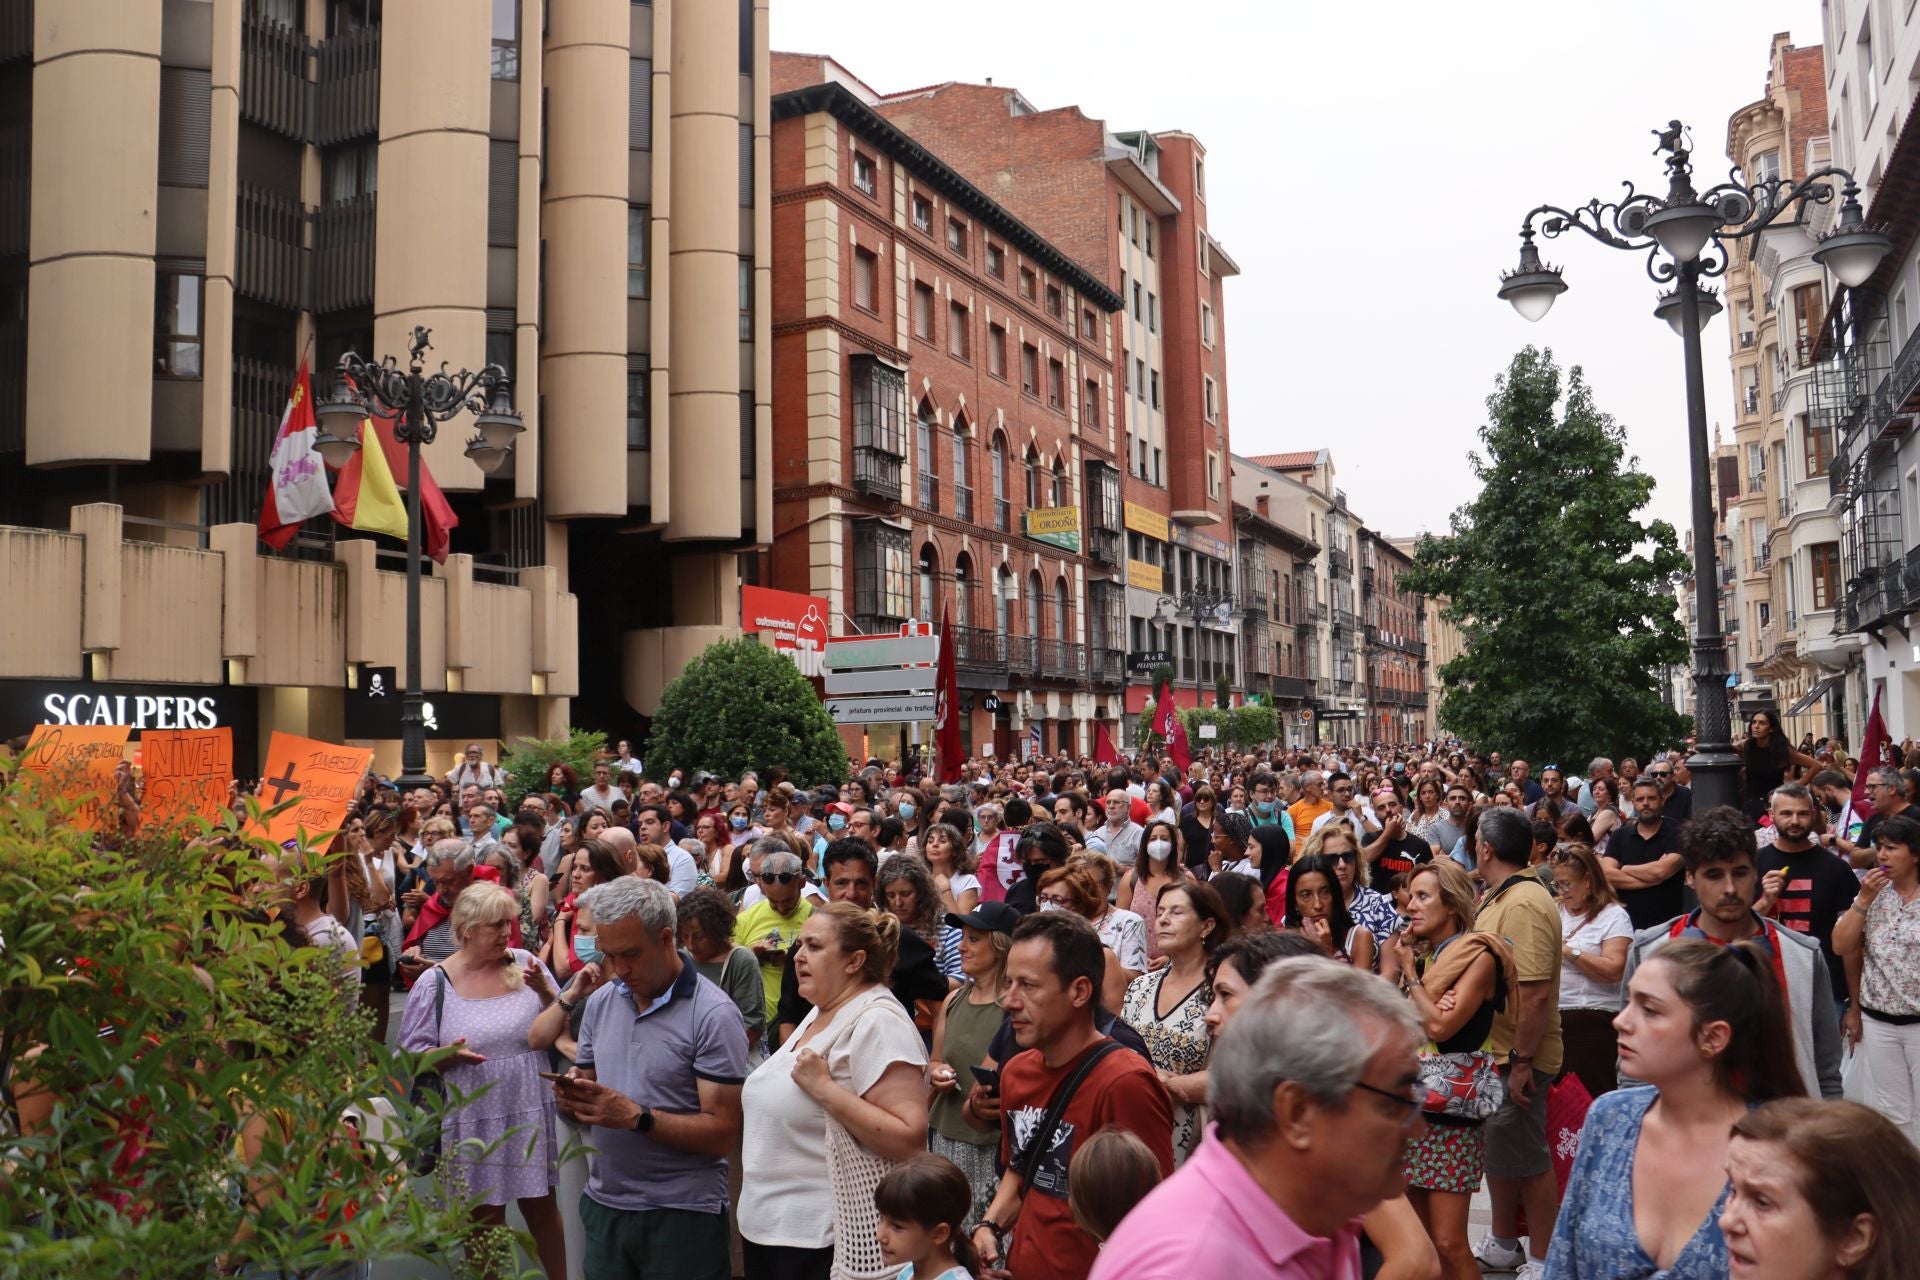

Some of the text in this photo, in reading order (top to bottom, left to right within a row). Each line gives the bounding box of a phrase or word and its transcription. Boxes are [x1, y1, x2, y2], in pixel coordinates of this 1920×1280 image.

[1040, 516, 1076, 529] ORDOÑO
[1143, 653, 1150, 661] A
[1157, 652, 1164, 661] R
[849, 707, 872, 715] jefatura
[873, 705, 902, 714] provincial
[904, 704, 913, 712] de
[986, 699, 997, 709] IN
[44, 693, 217, 730] SCALPERS
[33, 728, 62, 765] 10
[292, 805, 331, 828] MEDIOS
